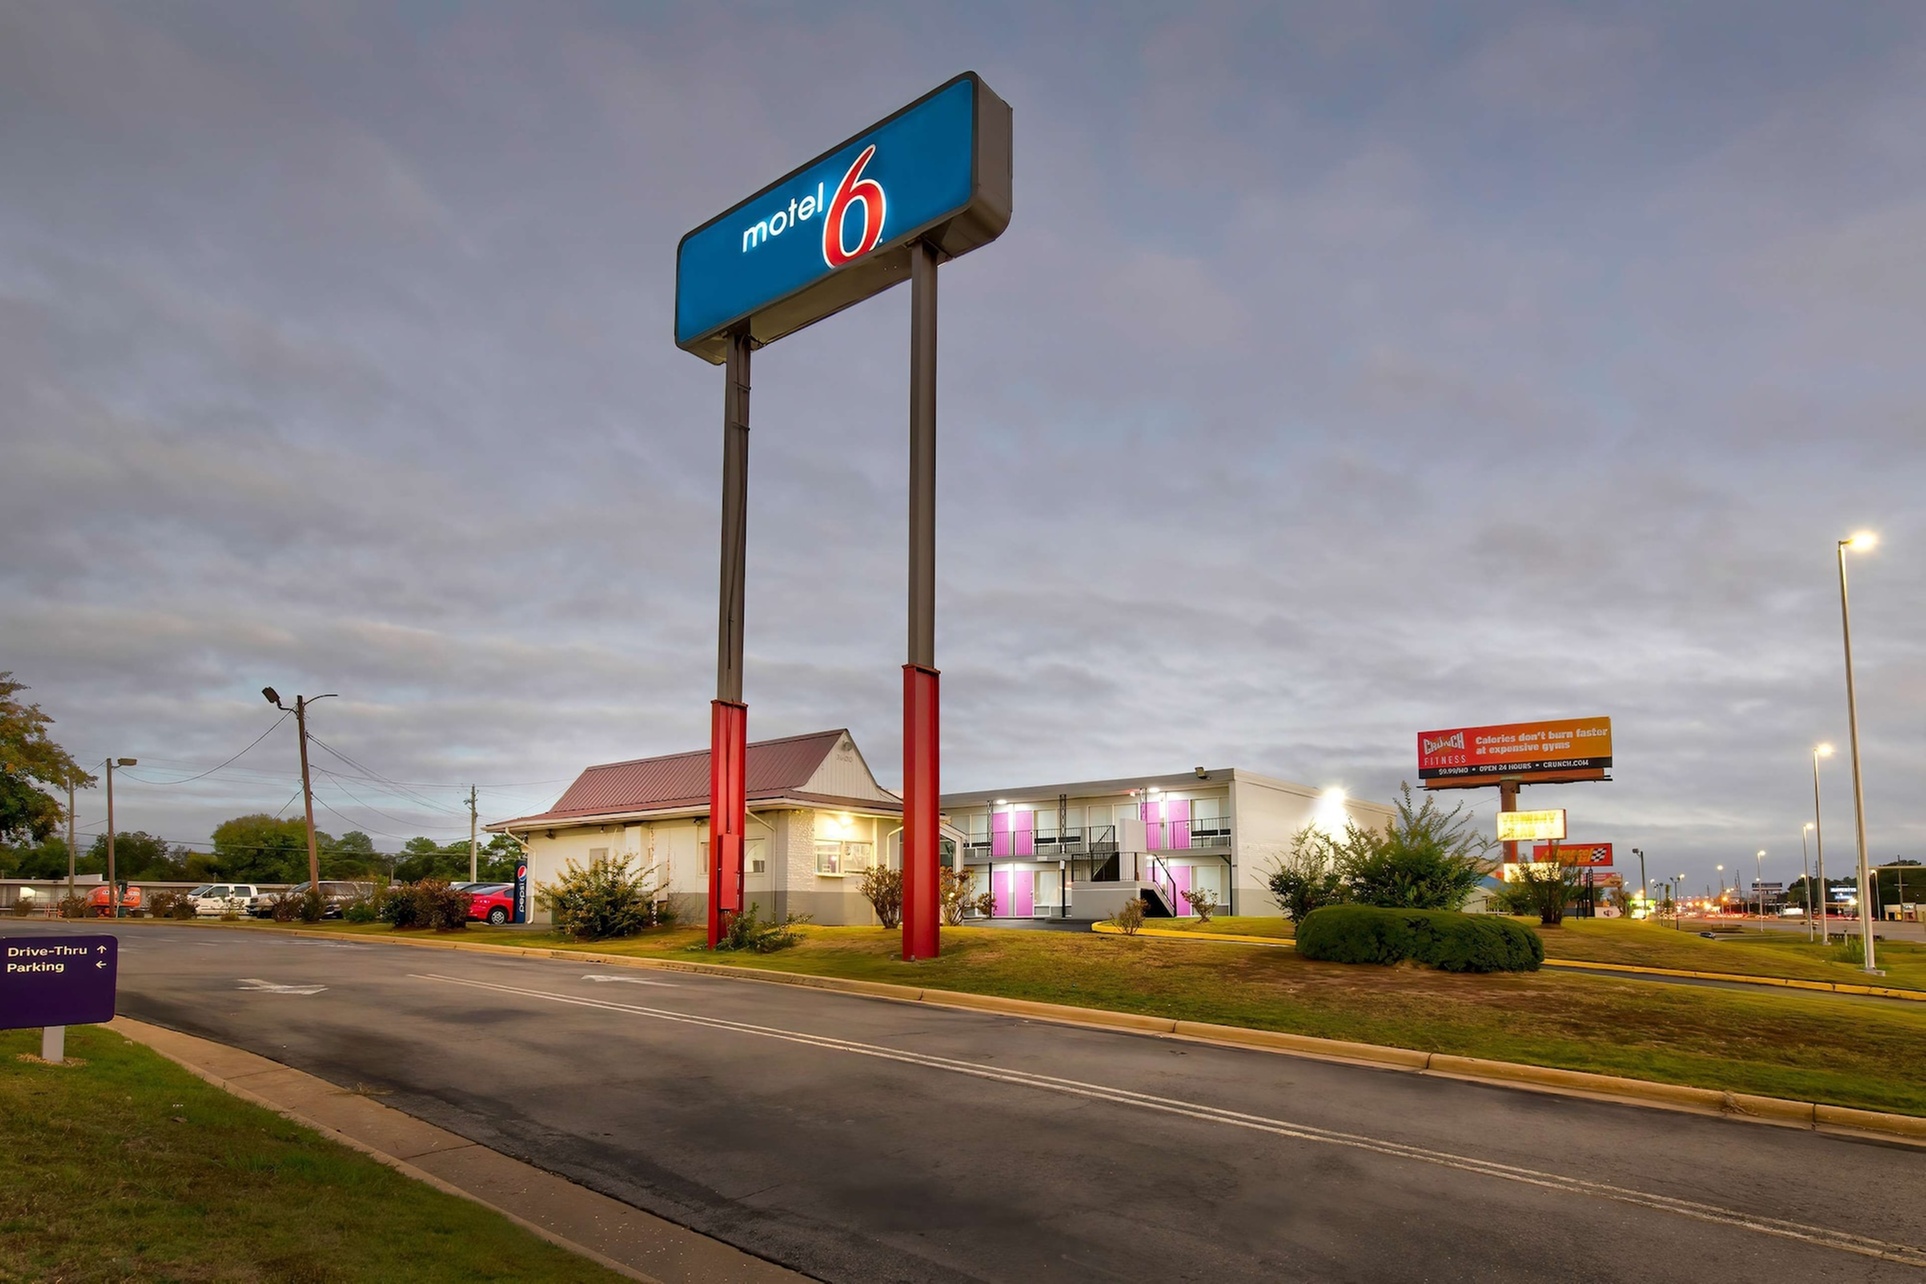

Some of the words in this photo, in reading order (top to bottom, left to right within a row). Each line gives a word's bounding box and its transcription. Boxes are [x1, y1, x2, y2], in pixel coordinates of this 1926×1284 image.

[743, 182, 824, 253] motel
[822, 144, 887, 270] 6
[1423, 732, 1465, 755] CRUNCH
[1475, 734, 1516, 746] Calories
[1518, 731, 1546, 742] don't
[1548, 730, 1573, 740] burn
[1576, 727, 1608, 738] faster
[1475, 746, 1486, 756] at
[1489, 743, 1539, 755] expensive
[1542, 741, 1571, 752] gyms
[1424, 755, 1466, 766] FITNESS
[1479, 765, 1498, 773] OPEN
[1499, 764, 1507, 772] 24
[1508, 762, 1531, 770] HOURS
[1543, 759, 1589, 769] CRUNCH.COM
[7, 946, 88, 957] Drive-Thru
[7, 962, 65, 973] Parking
